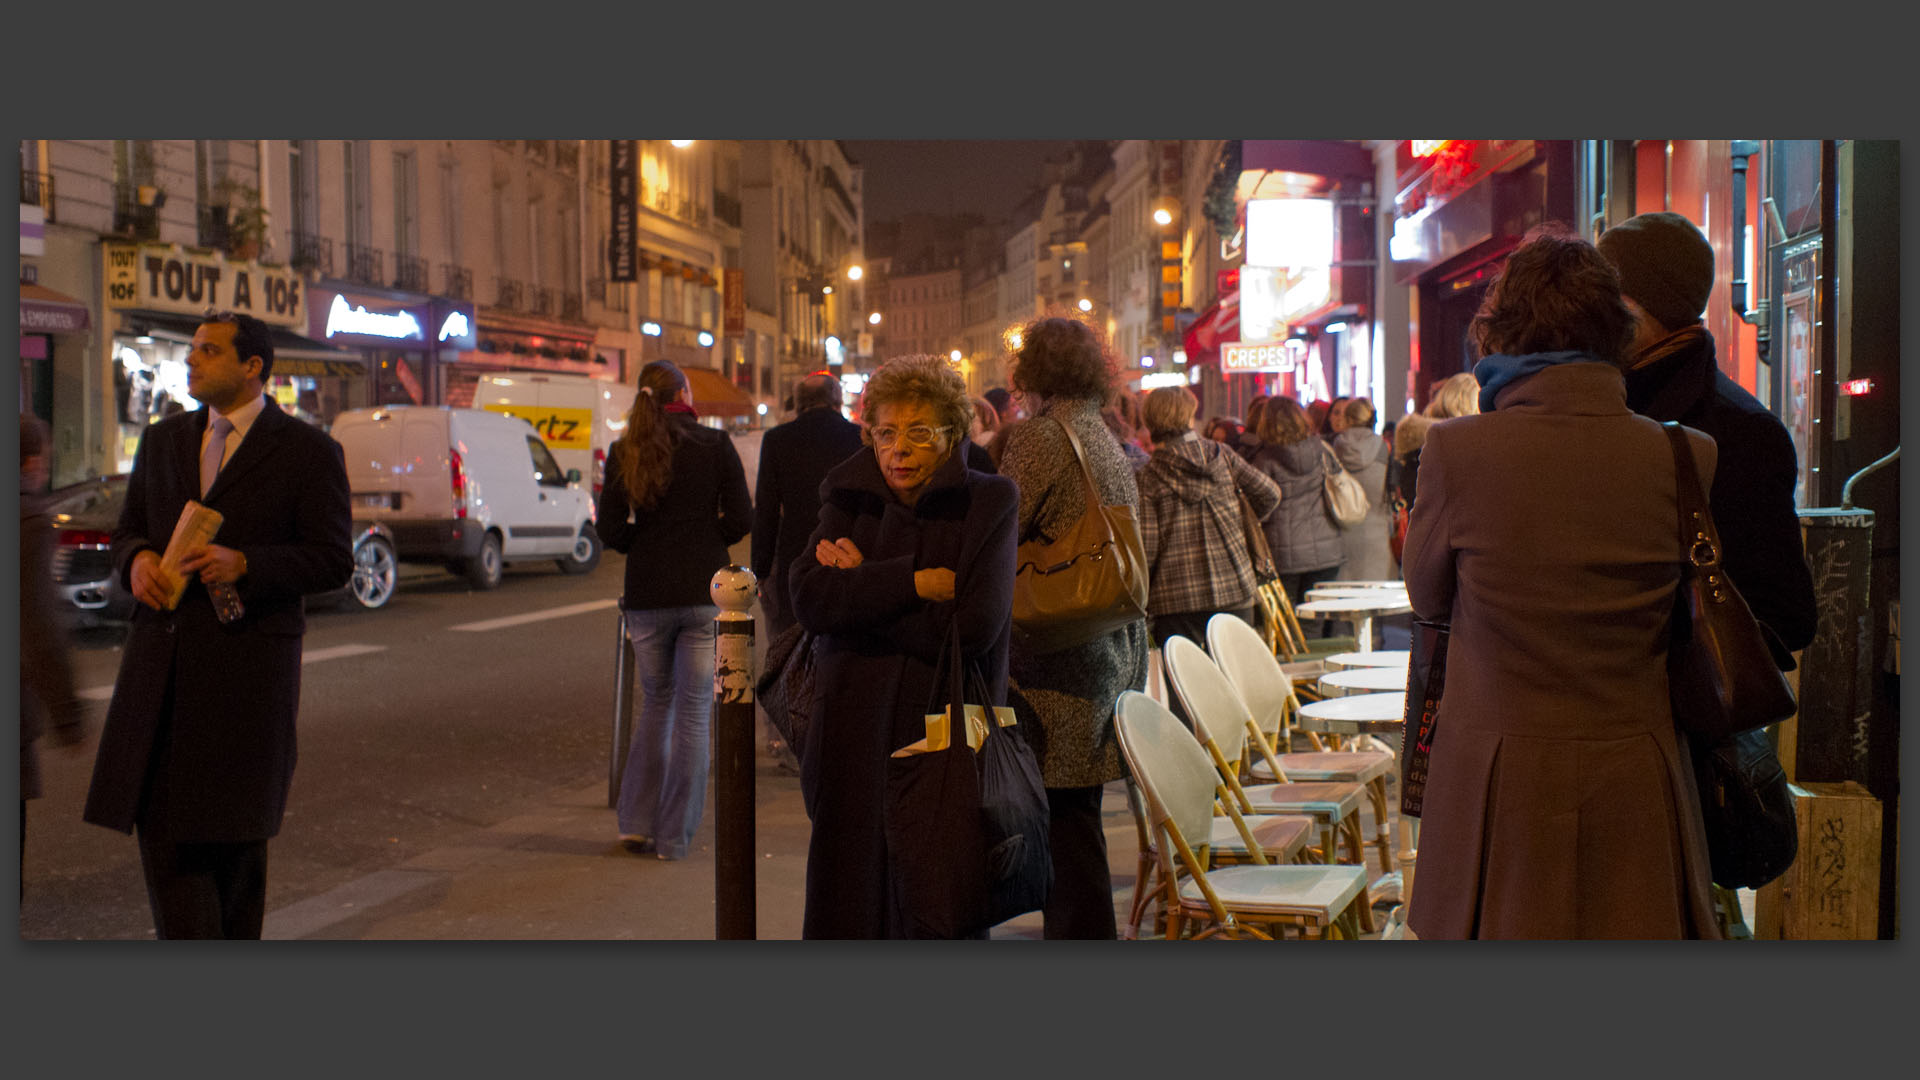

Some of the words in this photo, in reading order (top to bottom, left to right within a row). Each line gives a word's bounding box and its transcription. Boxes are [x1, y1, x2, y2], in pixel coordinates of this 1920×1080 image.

[110, 251, 135, 266] TOUT
[146, 256, 220, 304] TOUT
[1226, 347, 1287, 367] CREPES
